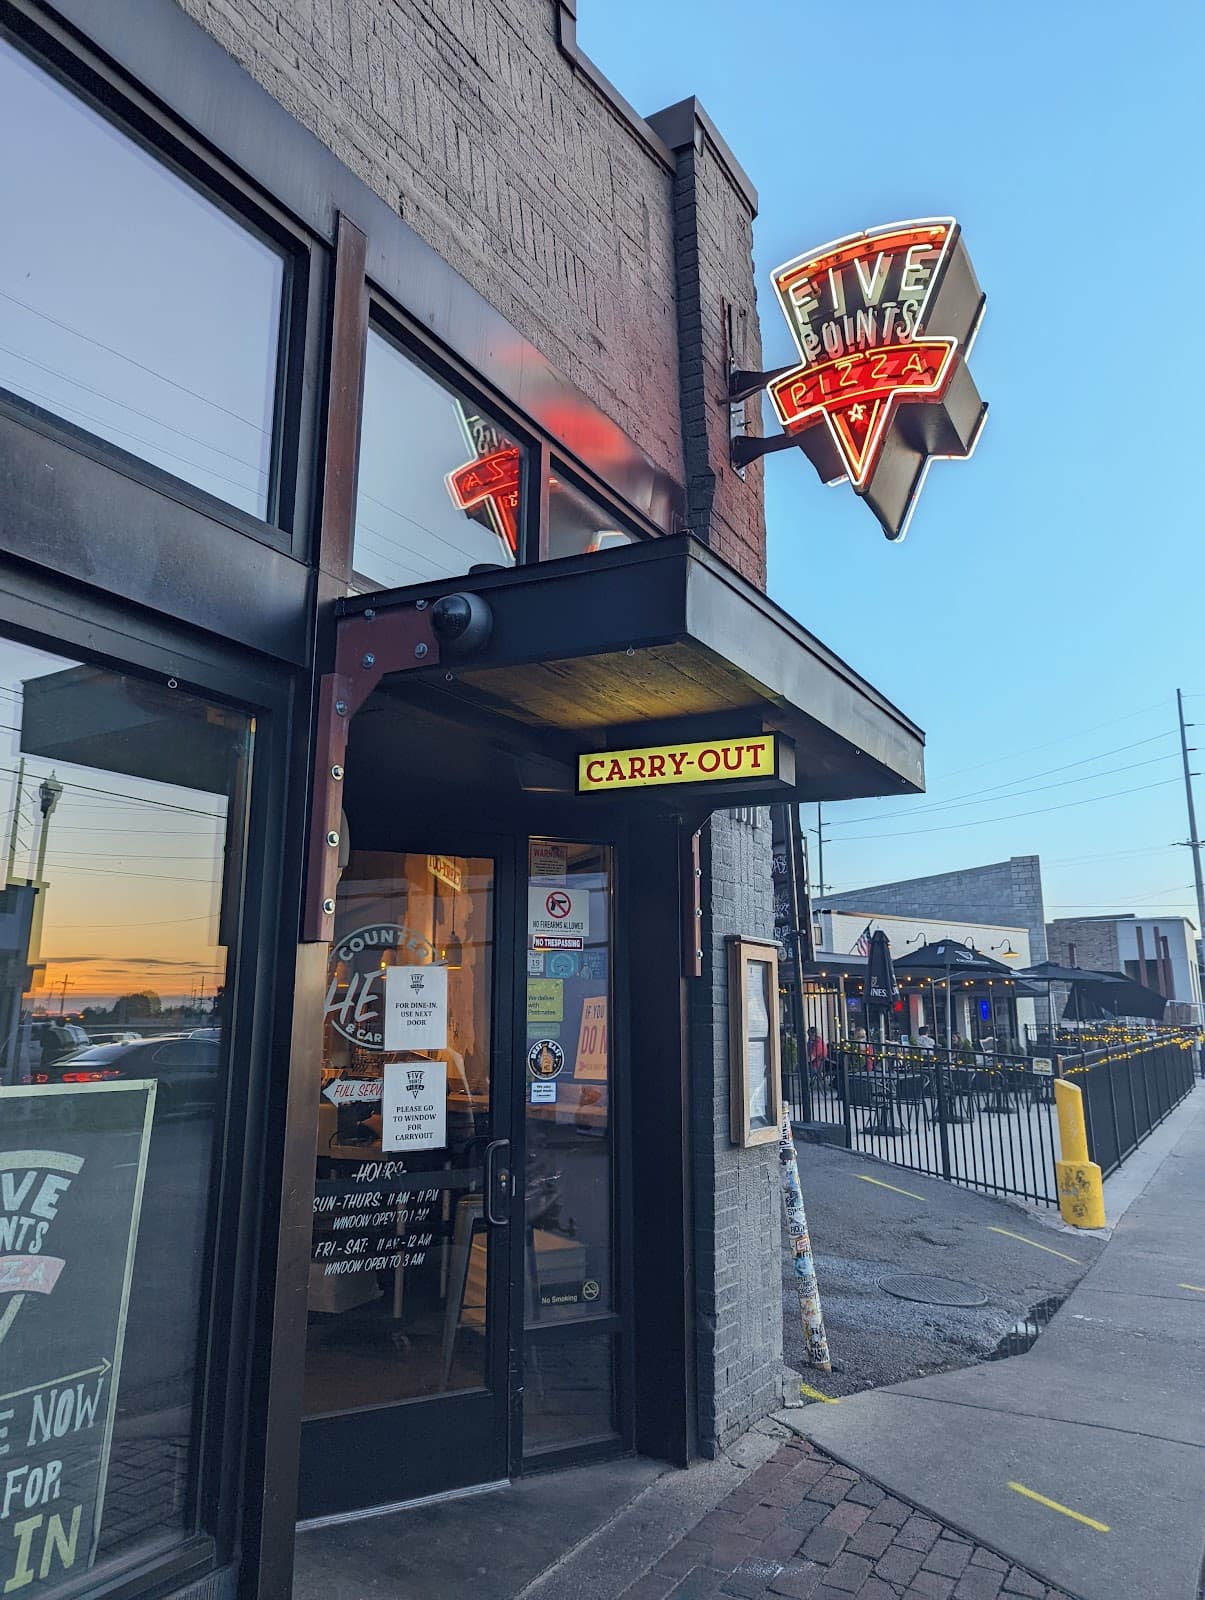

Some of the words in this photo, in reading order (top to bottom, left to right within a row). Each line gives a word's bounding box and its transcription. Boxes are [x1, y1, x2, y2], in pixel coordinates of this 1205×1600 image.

[788, 244, 942, 328] FIVE
[802, 299, 922, 360] POINTS
[790, 353, 932, 410] PIZZA
[586, 744, 765, 783] CARRY-OUT
[540, 921, 562, 930] FIREARMS
[563, 922, 584, 931] ALLOWED
[535, 938, 543, 946] NO
[346, 1025, 356, 1034] &
[581, 1025, 597, 1054] DO
[531, 1042, 543, 1059] BEST
[334, 1083, 354, 1097] FULL
[396, 1105, 422, 1113] PLEASE
[404, 1114, 437, 1122] WINDOW
[395, 1133, 433, 1141] CARRYOUT
[396, 1192, 410, 1205] AM
[425, 1188, 439, 1201] PM
[333, 1213, 372, 1230] WINDOW
[396, 1209, 408, 1223] TO
[407, 1234, 417, 1248] 12
[417, 1233, 433, 1246] AM
[324, 1258, 366, 1276] WINDOW
[364, 1256, 389, 1271] OPEN
[389, 1254, 401, 1268] TO
[402, 1253, 410, 1267] 3
[410, 1252, 426, 1266] AM
[551, 1295, 578, 1303] Smoking
[27, 1377, 104, 1446] NOW
[1, 1460, 62, 1519] FOR
[4, 1503, 83, 1594] IN
